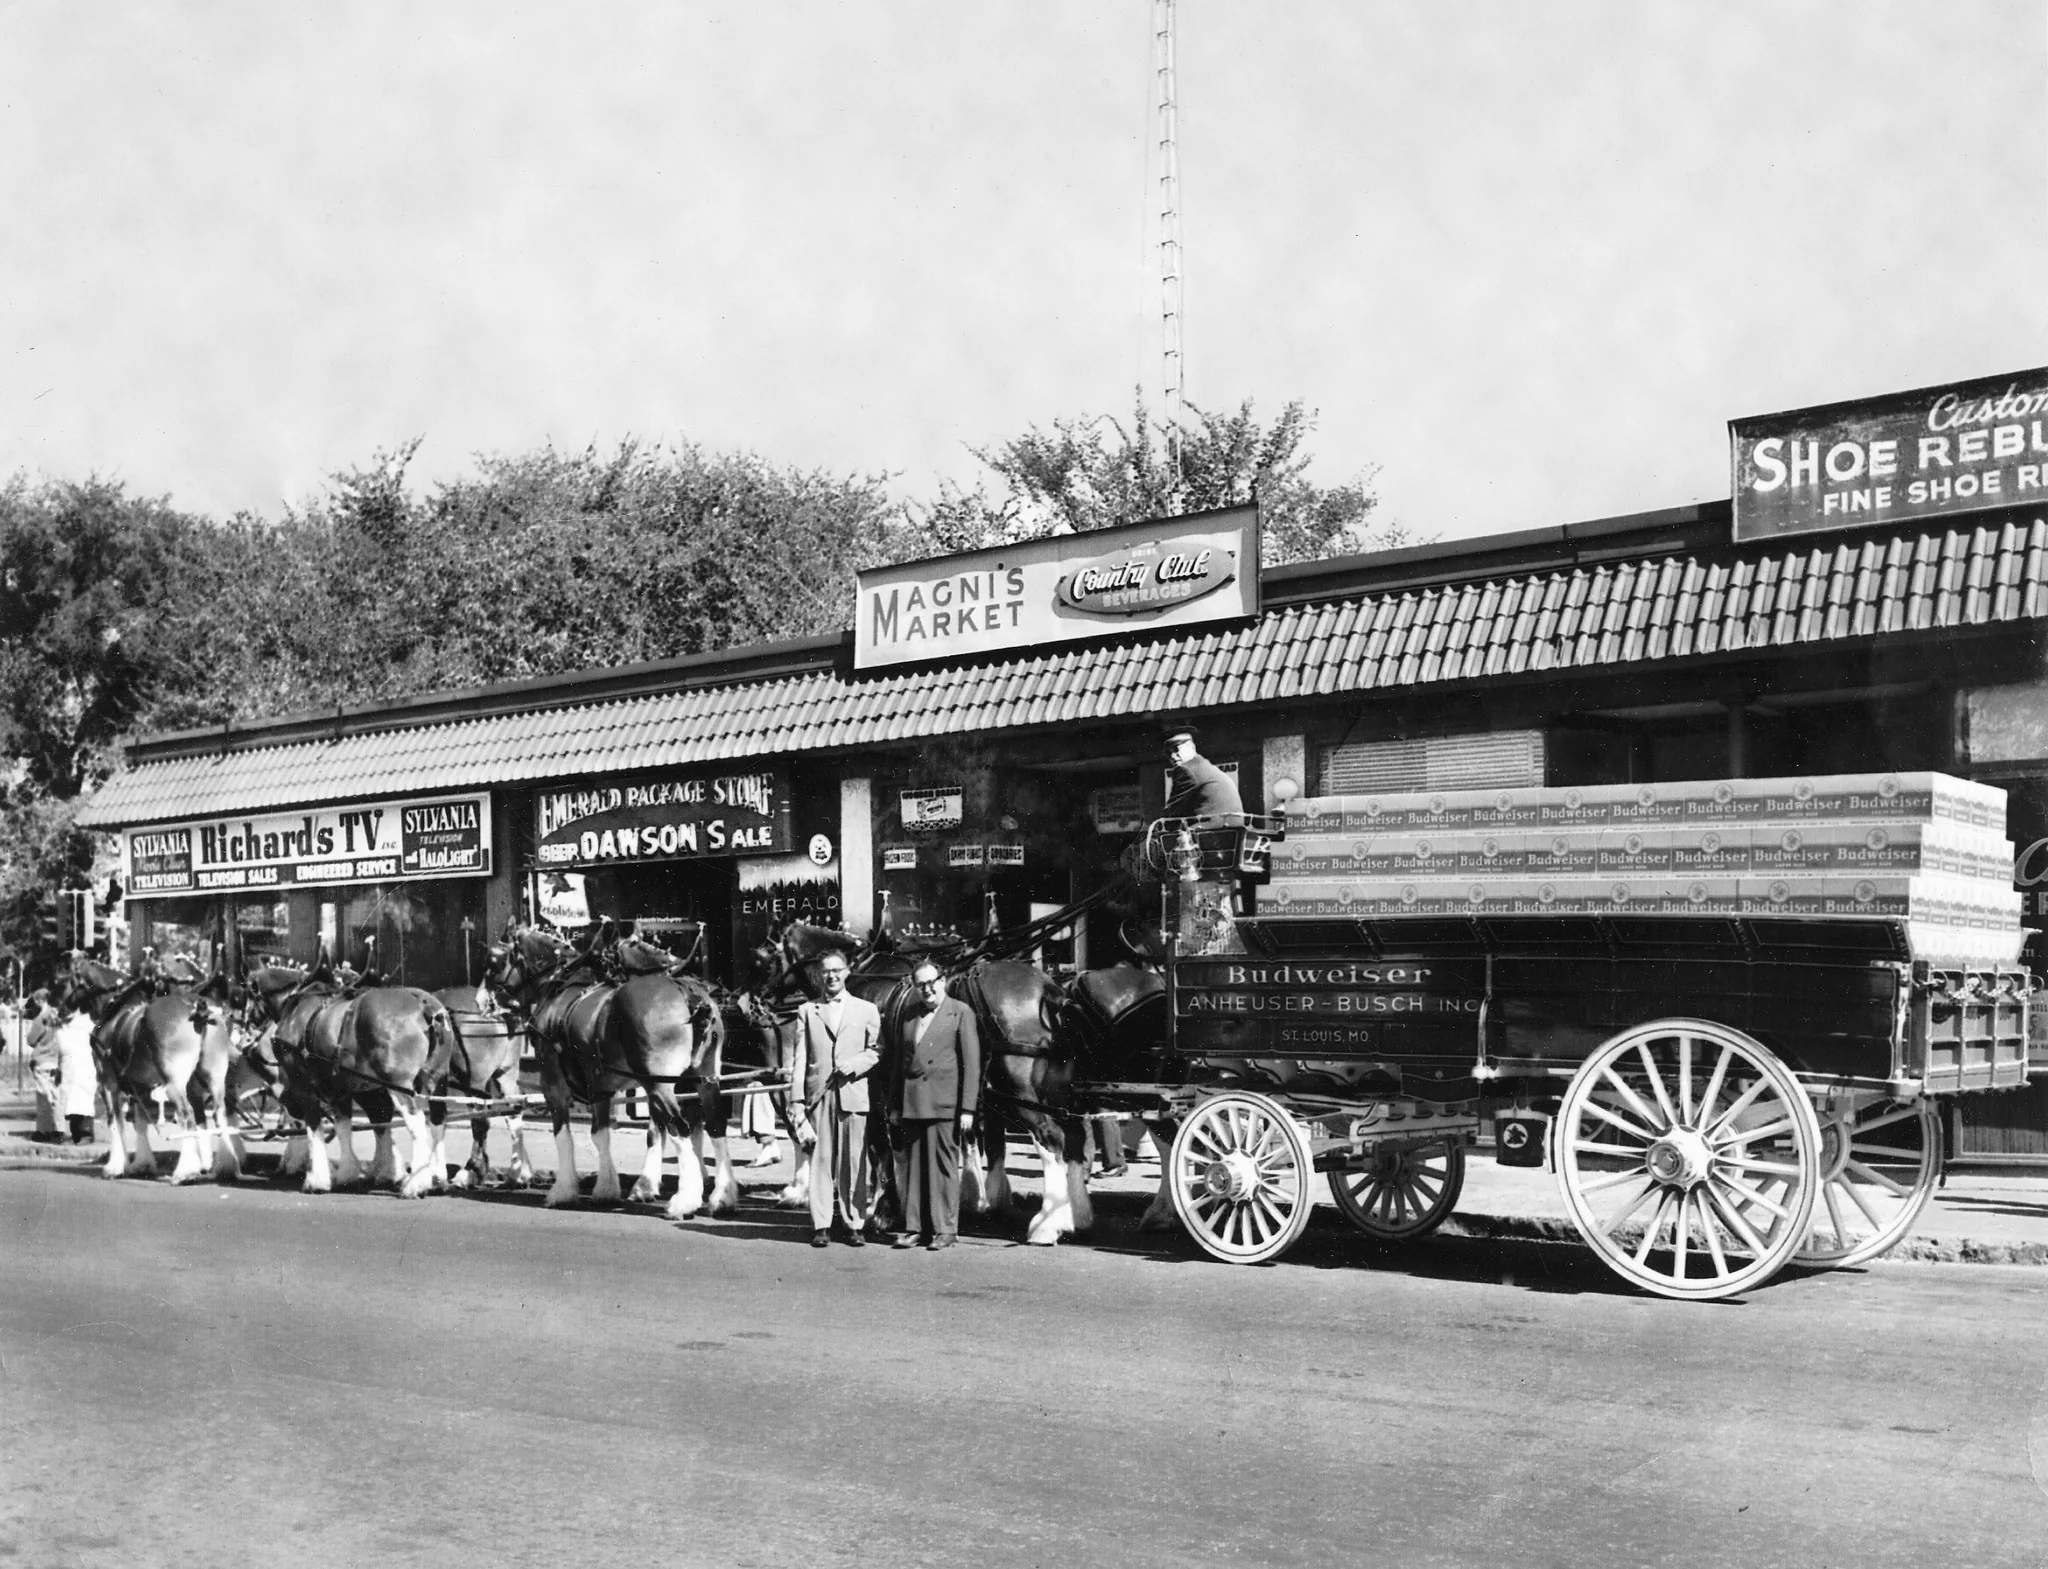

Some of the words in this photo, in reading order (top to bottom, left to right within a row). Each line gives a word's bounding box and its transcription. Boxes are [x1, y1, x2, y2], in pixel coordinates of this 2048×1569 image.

[1753, 438, 1898, 492] SHOE
[1824, 487, 1893, 516] FINE
[1908, 470, 2001, 504] SHOE
[1072, 561, 1151, 601] Country
[1157, 549, 1212, 584] Club
[1102, 582, 1192, 607] BEVERAGES
[873, 590, 1024, 646] MARKET
[539, 788, 622, 839] EMERALD
[626, 780, 706, 807] PACKAGE
[712, 773, 774, 818] STORE
[1688, 801, 1760, 814] Budweiser
[1766, 799, 1842, 812] Budweiser
[1848, 796, 1929, 809] Budweiser
[1474, 809, 1535, 821] Budweiser
[1542, 807, 1607, 819] Budweiser
[1613, 804, 1680, 817] Budweiser
[405, 804, 478, 834] SYLVANIA
[1286, 817, 1341, 828] Budweiser
[1346, 815, 1402, 826] Budweiser
[1408, 812, 1468, 824] Budweiser
[199, 816, 334, 864] Richard's
[339, 809, 383, 853] TV
[731, 826, 773, 848] ALE
[133, 833, 189, 858] SYLVANIA
[1528, 853, 1594, 865] Budweiser
[1600, 852, 1669, 864] Budweiser
[1675, 850, 1748, 863] Budweiser
[1755, 849, 1831, 861] Budweiser
[1837, 847, 1918, 860] Budweiser
[1272, 859, 1327, 870] Budweiser
[1332, 858, 1389, 869] Budweiser
[1394, 856, 1454, 868] Budweiser
[1460, 855, 1523, 866] Budweiser
[248, 867, 278, 884] SALES
[356, 858, 397, 877] SERVICE
[135, 872, 189, 889] TELEVISION
[743, 895, 838, 914] EMERALD
[1257, 903, 1312, 913] Budweiser
[1317, 902, 1374, 913] Budweiser
[1380, 901, 1440, 912] Budweiser
[1446, 901, 1508, 912] Budweiser
[1514, 900, 1580, 913] Budweiser
[1587, 900, 1656, 913] Budweiser
[1662, 900, 1735, 913] Budweiser
[1742, 900, 1818, 913] Budweiser
[1825, 899, 1908, 913] Budweiser
[1228, 965, 1432, 984] Budweiser
